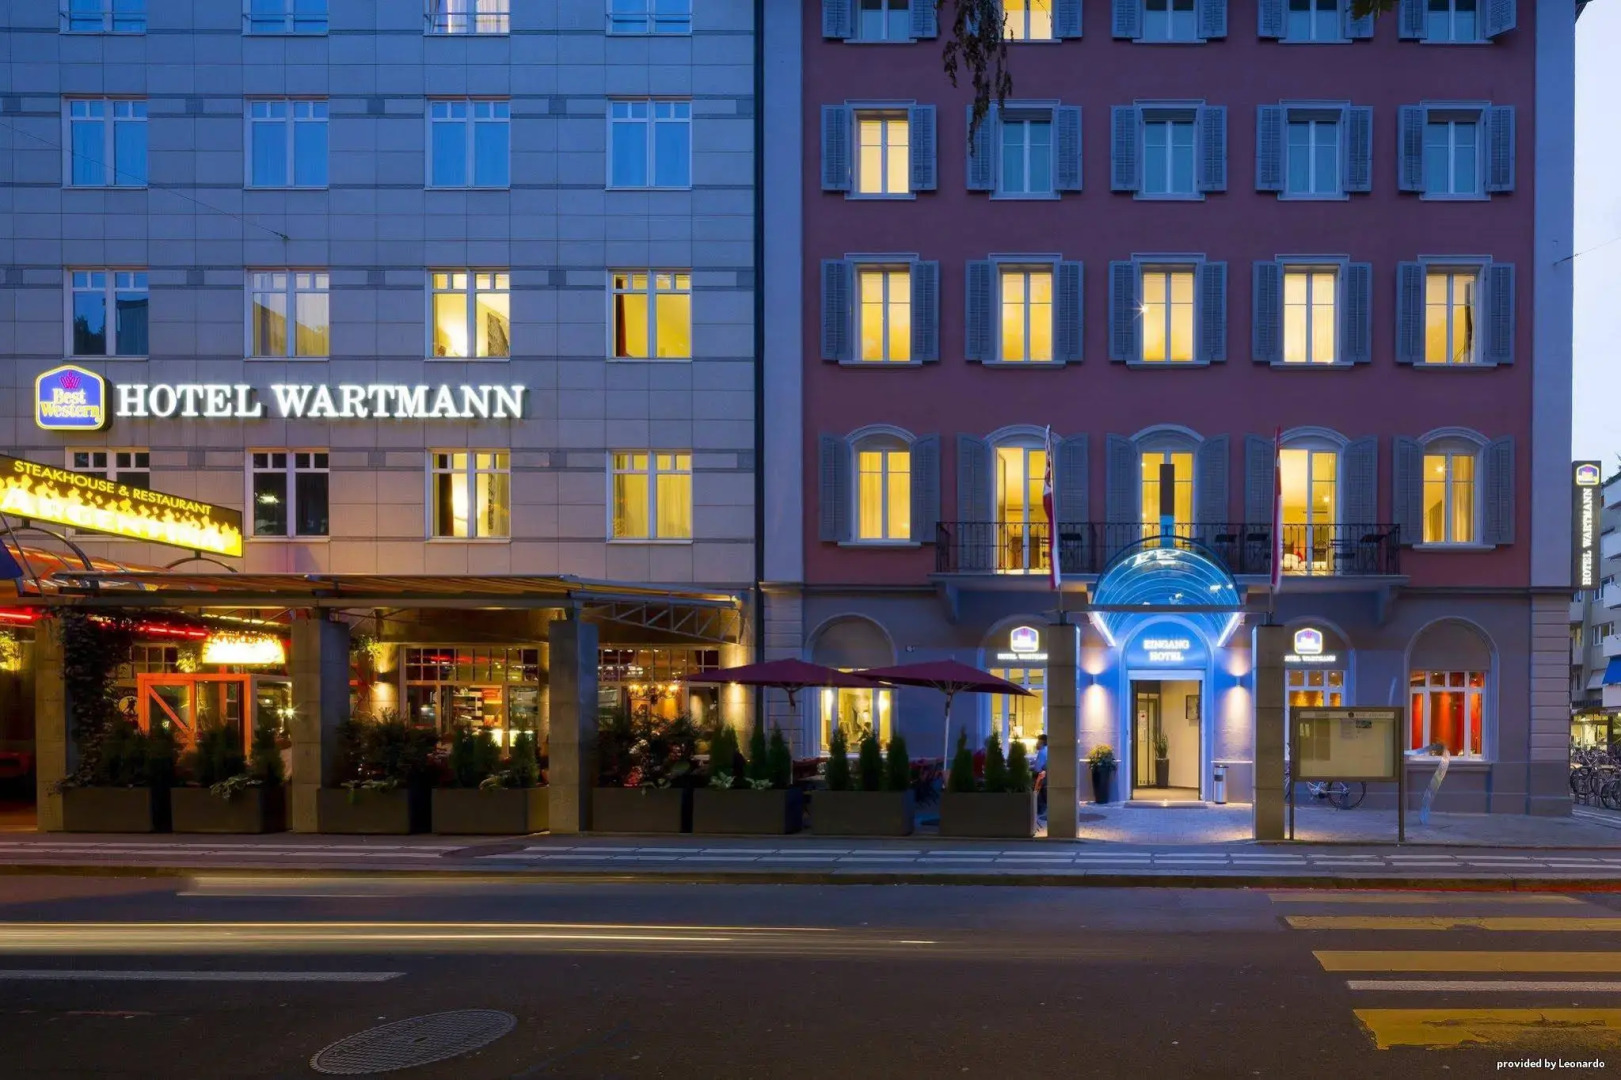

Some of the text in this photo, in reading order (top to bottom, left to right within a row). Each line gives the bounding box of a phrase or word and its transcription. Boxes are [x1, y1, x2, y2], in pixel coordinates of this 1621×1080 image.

[40, 401, 100, 418] Western
[52, 388, 87, 404] Best
[116, 384, 525, 418] HOTEL WARTMANN
[14, 460, 212, 515] STEAKHOUSE & RESTAURANT
[1582, 487, 1593, 548] WARTMANN
[1582, 550, 1592, 586] HOTEL
